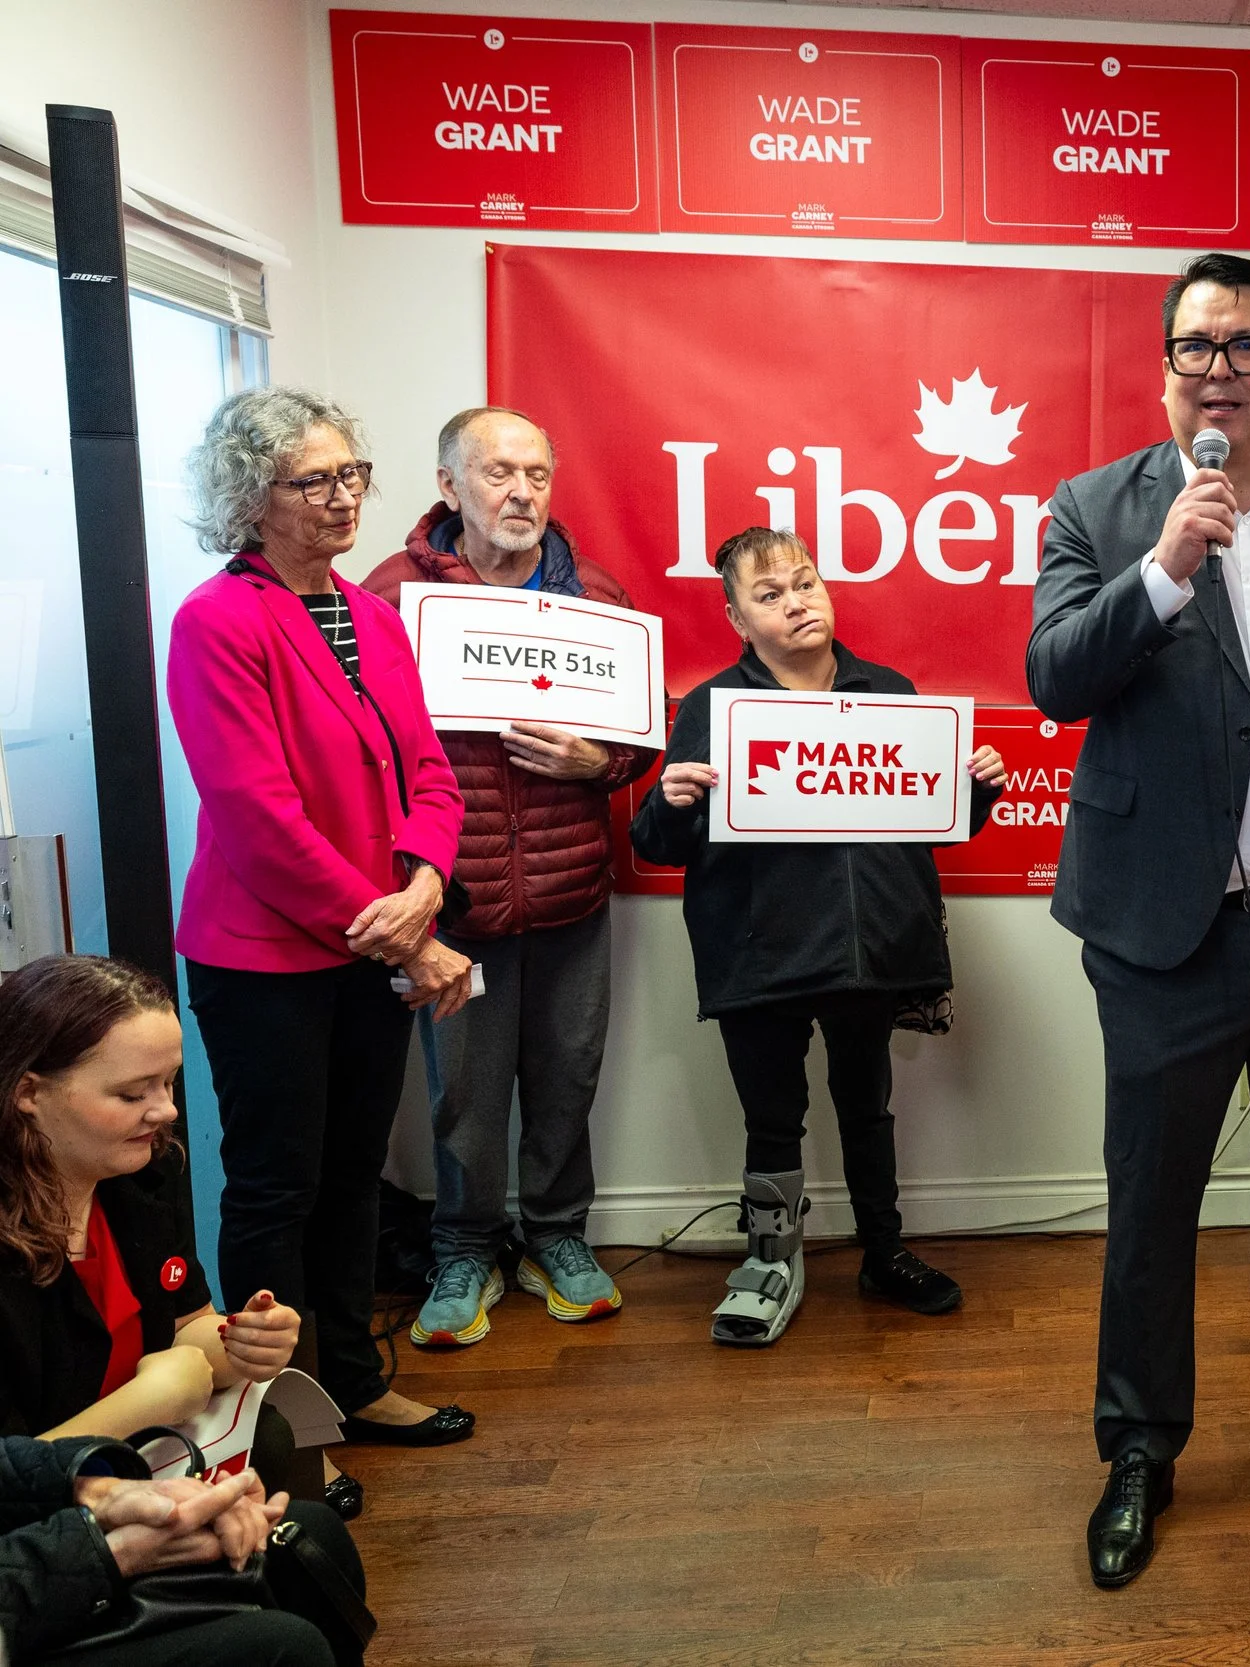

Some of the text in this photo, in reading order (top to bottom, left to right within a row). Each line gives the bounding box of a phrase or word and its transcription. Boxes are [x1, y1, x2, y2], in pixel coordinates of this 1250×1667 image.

[443, 82, 551, 114] WADE
[757, 95, 861, 126] WADE
[1061, 107, 1160, 138] WADE
[434, 121, 563, 153] GRANT
[749, 133, 872, 164] GRANT
[1053, 145, 1170, 175] GRANT
[480, 201, 525, 211] CARNEY
[487, 193, 516, 201] MARK
[798, 203, 826, 212] MARK
[791, 211, 834, 221] CARNEY
[1091, 222, 1132, 231] CARNEY
[1098, 214, 1124, 222] MARK
[63, 273, 118, 282] BOSE
[463, 643, 616, 679] NEVER 51st
[797, 741, 904, 768] MARK
[796, 769, 942, 796] CARNEY
[1005, 768, 1074, 792] WAD
[991, 801, 1070, 826] GRA
